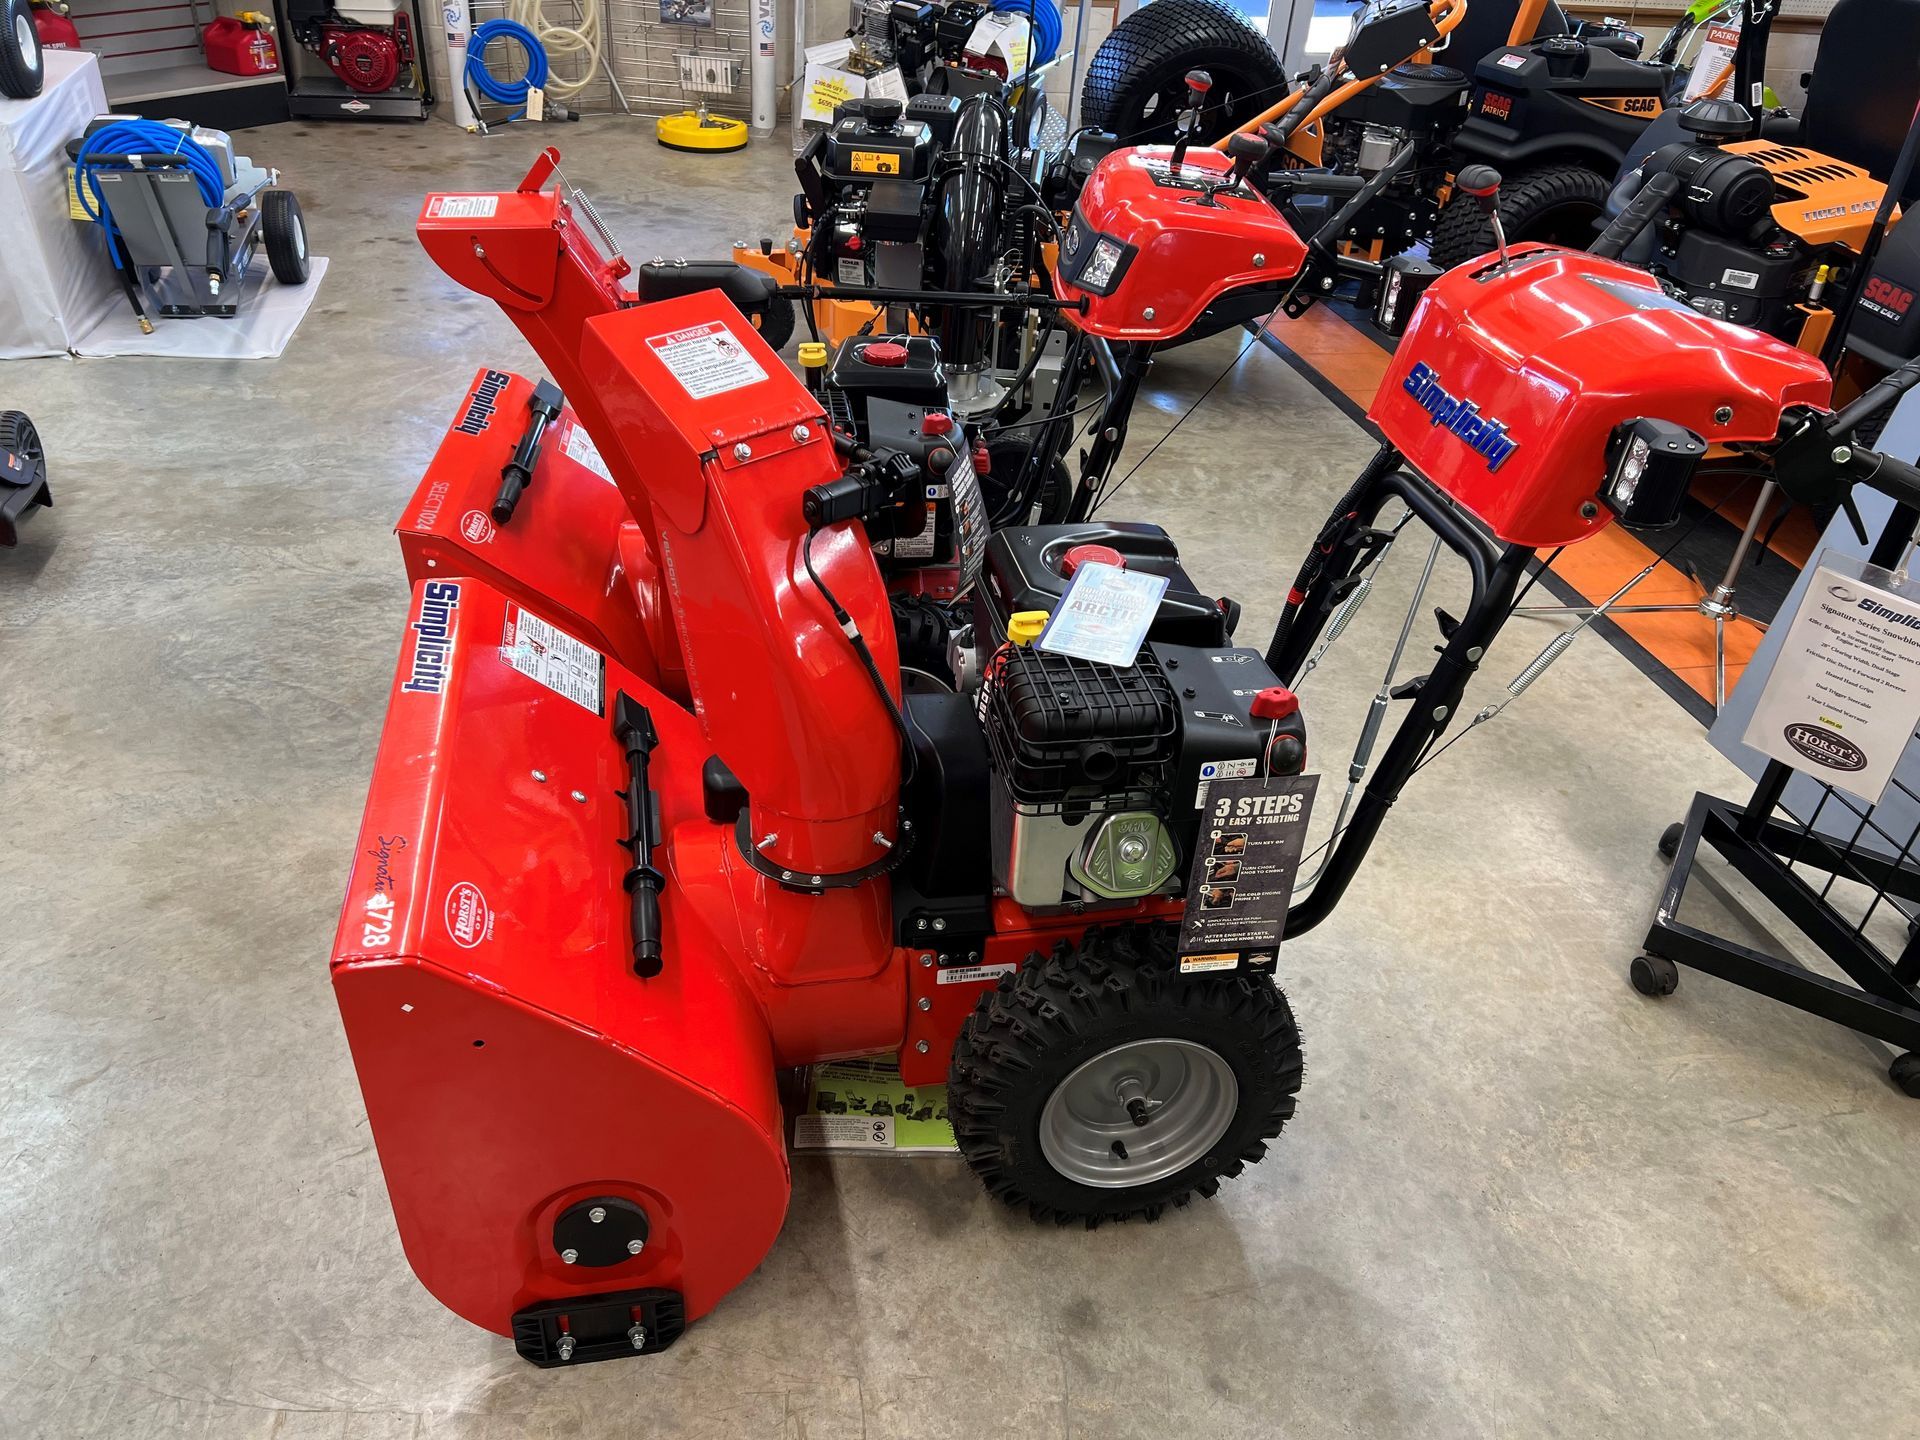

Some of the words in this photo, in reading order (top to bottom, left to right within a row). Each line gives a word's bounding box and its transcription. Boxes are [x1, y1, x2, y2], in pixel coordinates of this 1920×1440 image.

[1481, 104, 1509, 121] PATRIOT
[1484, 92, 1512, 111] SCAG
[1624, 98, 1656, 112] SCAG
[1802, 206, 1846, 222] TIGER
[1851, 200, 1878, 214] CAT
[1859, 298, 1880, 312] TIGER
[1880, 307, 1894, 318] CAT
[1864, 277, 1913, 313] SCAG
[657, 340, 692, 354] Amputation
[675, 327, 712, 341] DANGER
[454, 369, 510, 436] Simplicity
[1403, 360, 1519, 473] Simplicity
[1821, 602, 1857, 622] Signature
[1858, 618, 1881, 633] Series
[1882, 628, 1920, 648] Snowblow
[1857, 597, 1920, 631] Simplic
[403, 582, 460, 693] Simplicity
[1824, 624, 1841, 634] Briggs
[1847, 634, 1869, 646] Stratton
[1898, 654, 1915, 664] Series
[1836, 635, 1854, 647] Engine
[1861, 646, 1881, 659] electric
[1881, 654, 1895, 663] start
[1805, 648, 1826, 661] Friction
[1837, 662, 1852, 672] Drive
[1856, 670, 1881, 683] Forward
[1885, 681, 1907, 693] Reverse
[1831, 646, 1852, 660] Clearing
[1871, 663, 1885, 673] Dual
[1885, 668, 1901, 678] Stage
[1815, 682, 1828, 691] Dual
[1828, 688, 1847, 699] Trigger
[1825, 670, 1844, 682] Heated
[1843, 678, 1859, 688] Hand
[1858, 684, 1874, 694] Grips
[1822, 701, 1843, 714] Limited
[1843, 711, 1869, 725] Warranty
[1792, 727, 1860, 763] HORST'S
[1215, 797, 1232, 818] 3
[1236, 793, 1304, 817] STEPS
[1213, 818, 1225, 827] TO
[1228, 816, 1253, 826] EASY
[1255, 813, 1300, 825] STARTING
[454, 887, 472, 941] HORST'S
